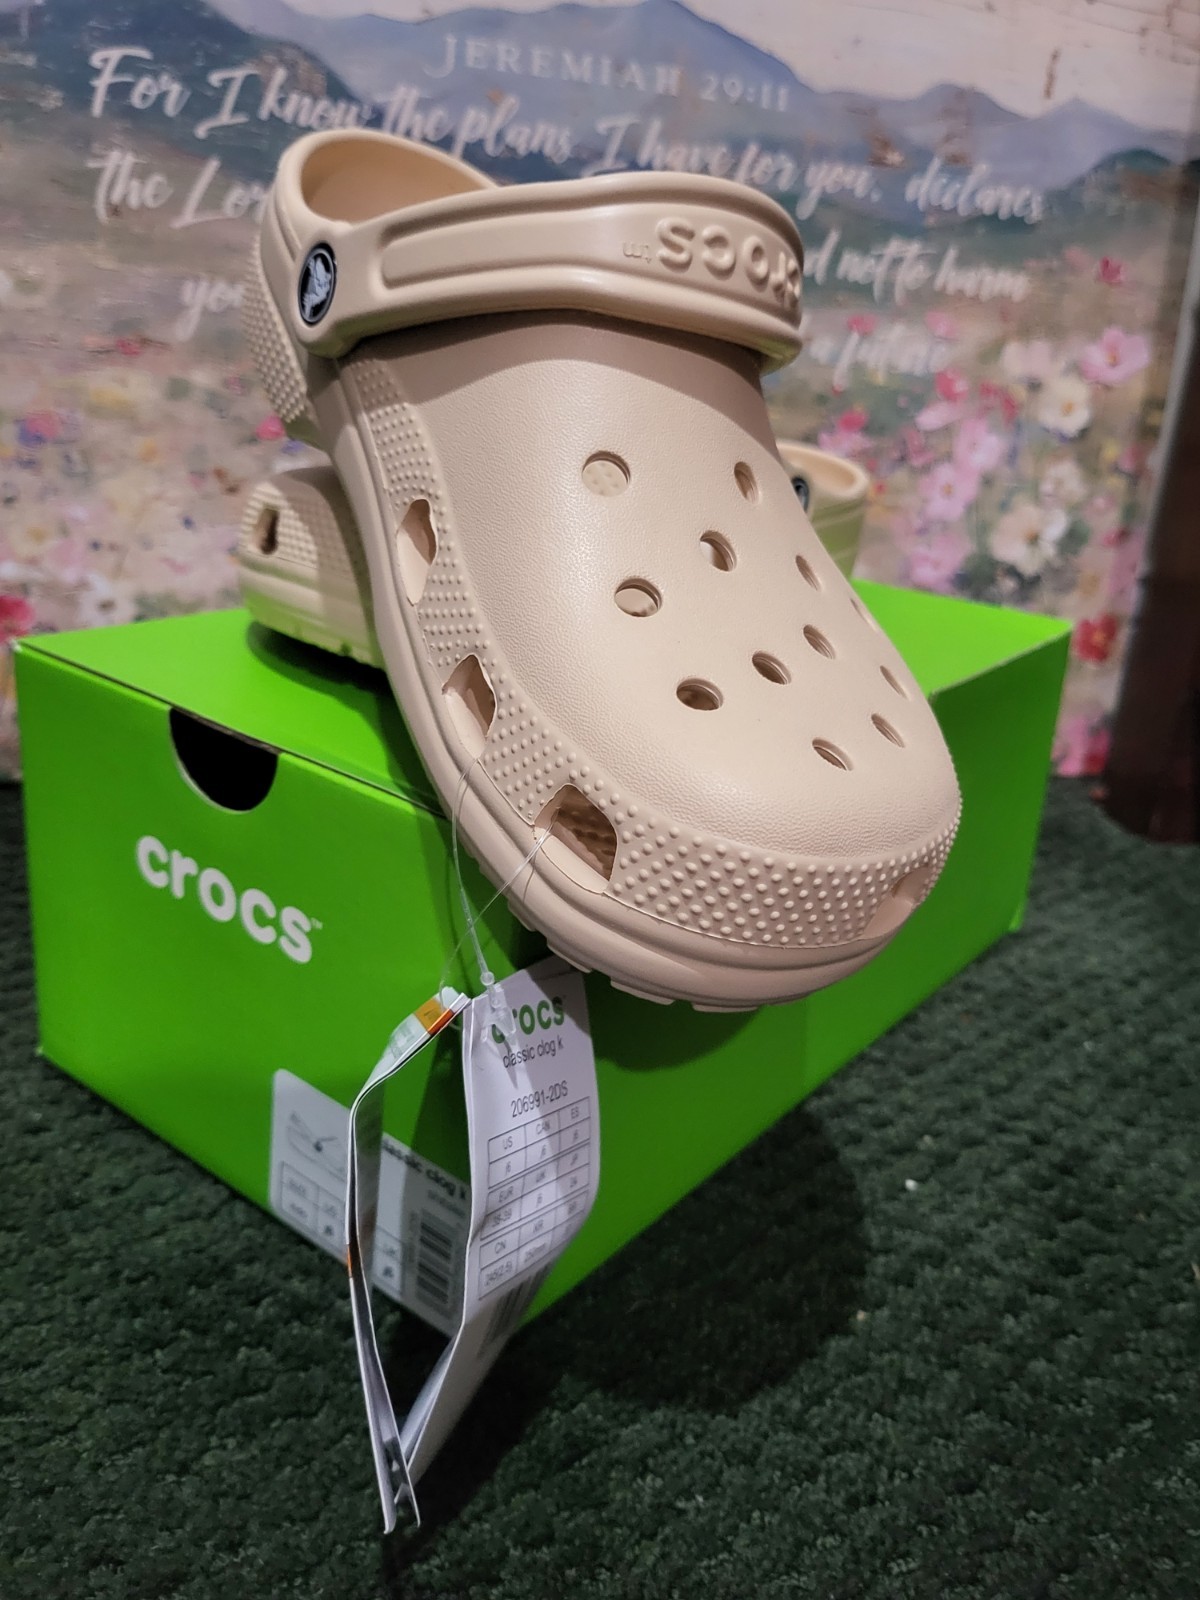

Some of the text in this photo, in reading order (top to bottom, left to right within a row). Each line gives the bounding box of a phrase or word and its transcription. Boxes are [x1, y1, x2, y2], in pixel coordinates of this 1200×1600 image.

[422, 33, 790, 112] JEREMIAH 29:11
[88, 46, 191, 118] For
[194, 65, 260, 139] I
[257, 66, 376, 131] know
[372, 82, 452, 142] the
[452, 95, 574, 165] plans
[580, 114, 641, 178] I
[637, 119, 737, 175] have
[732, 142, 798, 193] for
[86, 150, 174, 224] the
[136, 835, 313, 964] crocs
[502, 1044, 536, 1069] classic
[536, 1040, 558, 1057] clog
[510, 1079, 569, 1118] 206991-2DS
[502, 1135, 514, 1150] US
